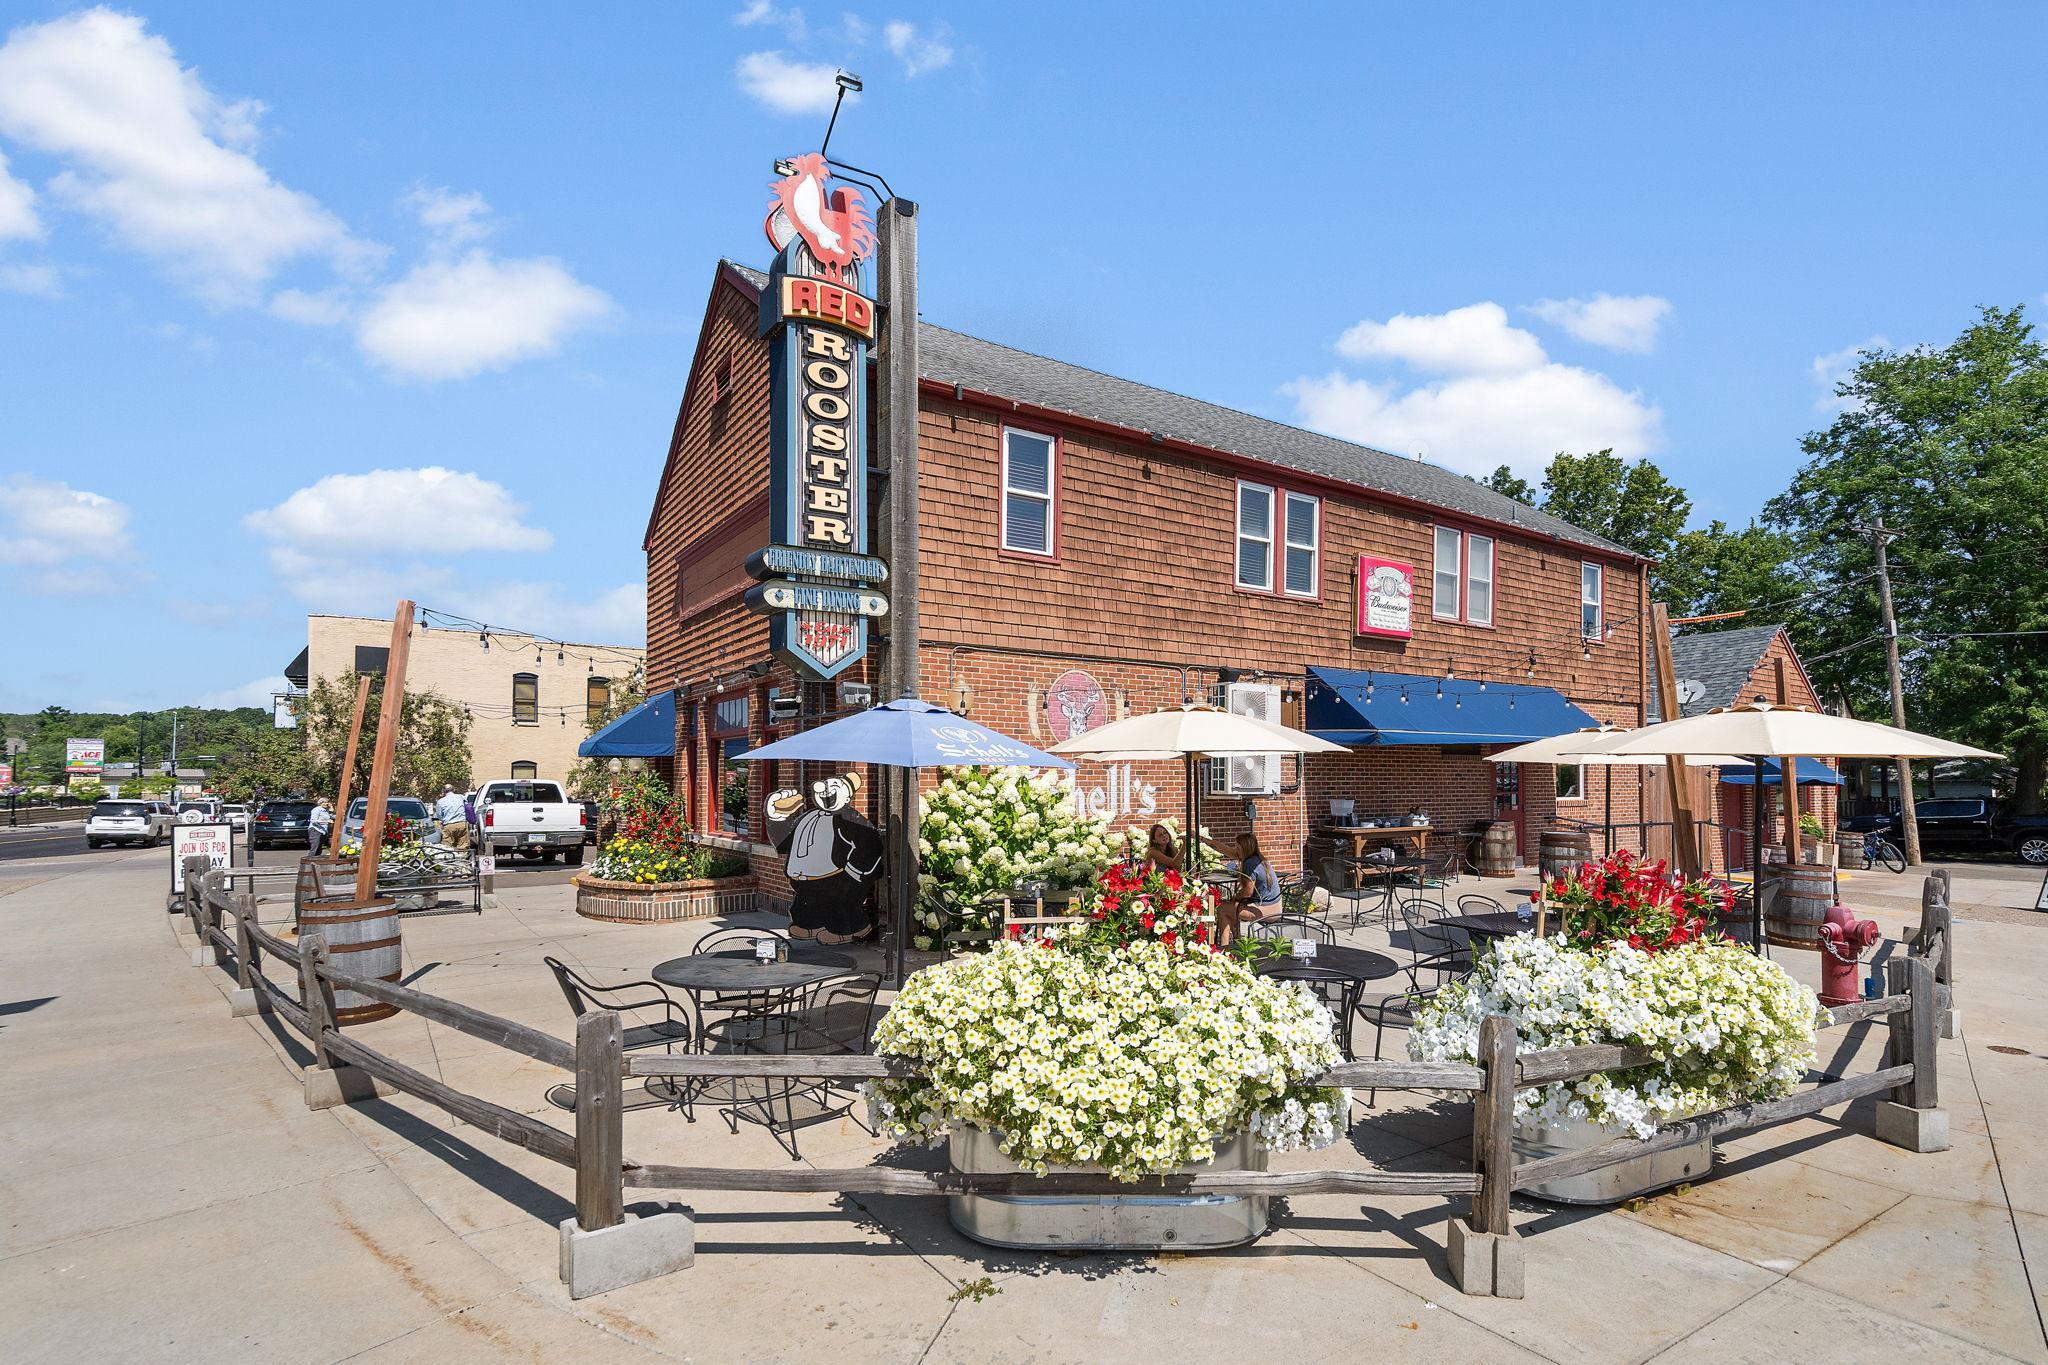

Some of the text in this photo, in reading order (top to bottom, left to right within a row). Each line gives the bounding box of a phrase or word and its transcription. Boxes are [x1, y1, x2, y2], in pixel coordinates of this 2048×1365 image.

[792, 280, 872, 329] RED
[806, 327, 852, 545] ROOSTER
[767, 548, 816, 571] FRIENDLY
[793, 586, 860, 610] FINE DINING
[1369, 595, 1407, 613] Budweiser
[804, 634, 848, 651] 1971
[935, 742, 1030, 759] Schell's
[1063, 761, 1157, 821] hell's
[179, 841, 226, 854] JOIN US FOR
